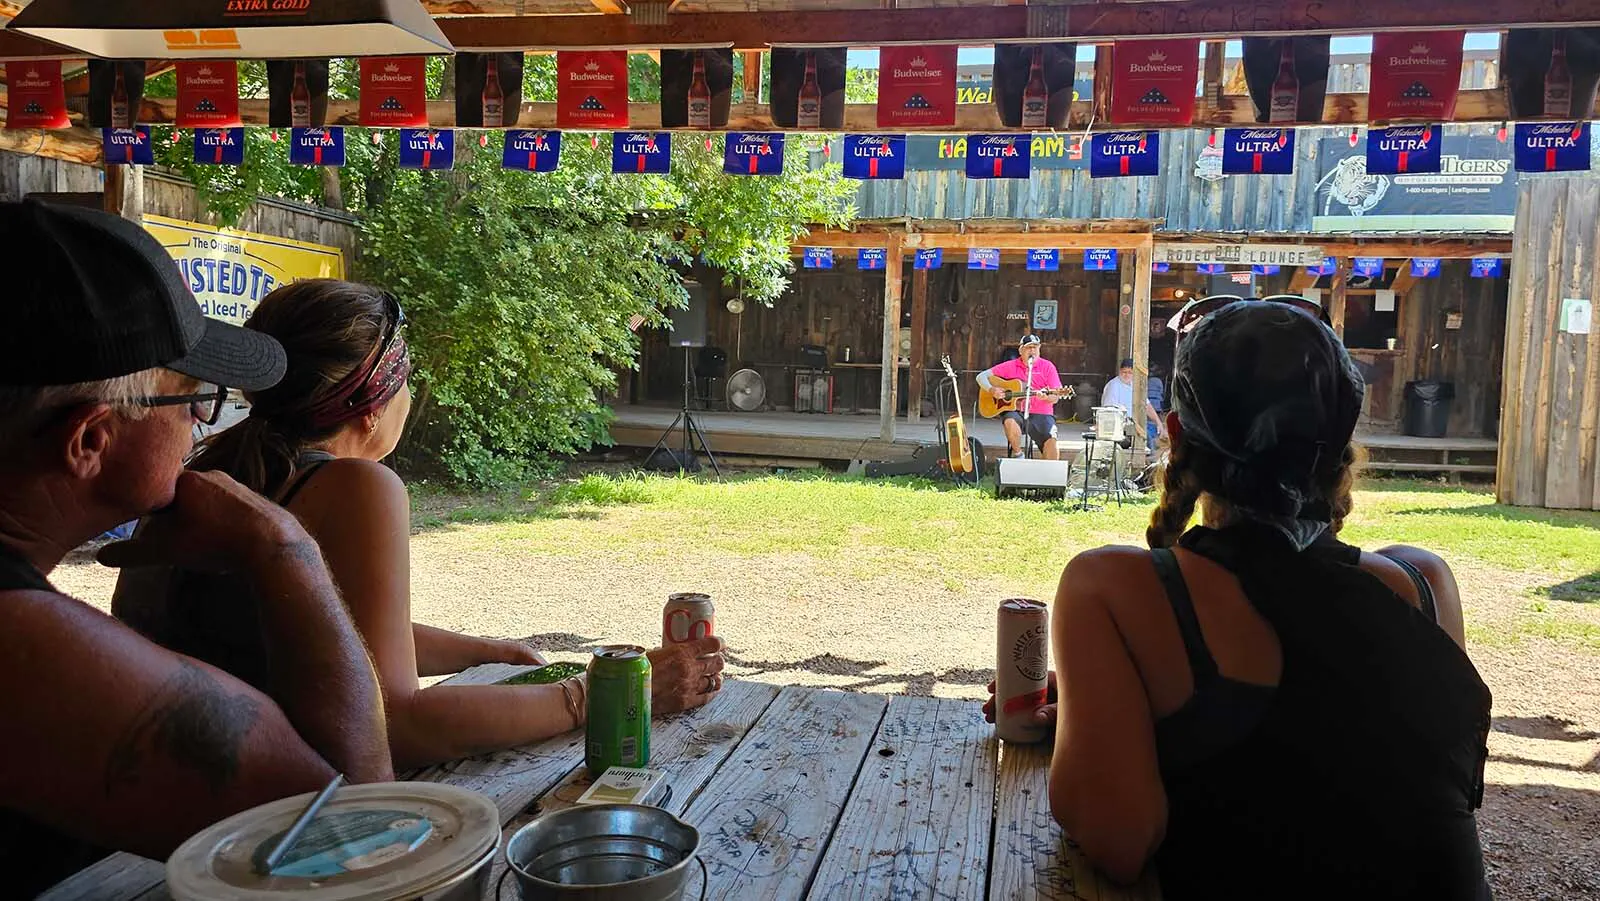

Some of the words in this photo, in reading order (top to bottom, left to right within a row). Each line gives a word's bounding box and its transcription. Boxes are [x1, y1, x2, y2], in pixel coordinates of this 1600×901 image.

[227, 0, 268, 10] EXTRA
[271, 0, 309, 9] GOLD
[1390, 56, 1447, 66] Budweiser
[1130, 63, 1184, 73] Budweiser
[372, 74, 412, 82] Budweiser
[570, 72, 614, 81] Budweiser
[894, 69, 942, 78] Budweiser
[111, 136, 143, 144] ULTRA
[202, 136, 234, 146] ULTRA
[300, 138, 335, 146] ULTRA
[410, 140, 444, 150] ULTRA
[1380, 139, 1427, 151] ULTRA
[1527, 138, 1576, 148] ULTRA
[514, 141, 551, 152] ULTRA
[623, 144, 660, 153] ULTRA
[978, 147, 1018, 156] ULTRA
[1103, 144, 1146, 155] ULTRA
[1236, 142, 1281, 152] ULTRA
[854, 148, 894, 157] ULTRA
[1441, 157, 1507, 173] TIGERS
[193, 237, 209, 249] The
[210, 239, 241, 254] Original
[1216, 246, 1240, 257] BAR
[1250, 251, 1305, 264] LOUNGE
[176, 258, 247, 296] ISTED
[250, 264, 284, 301] TE
[213, 300, 238, 318] Iced
[240, 304, 253, 320] Te
[1014, 629, 1034, 662] WHITE
